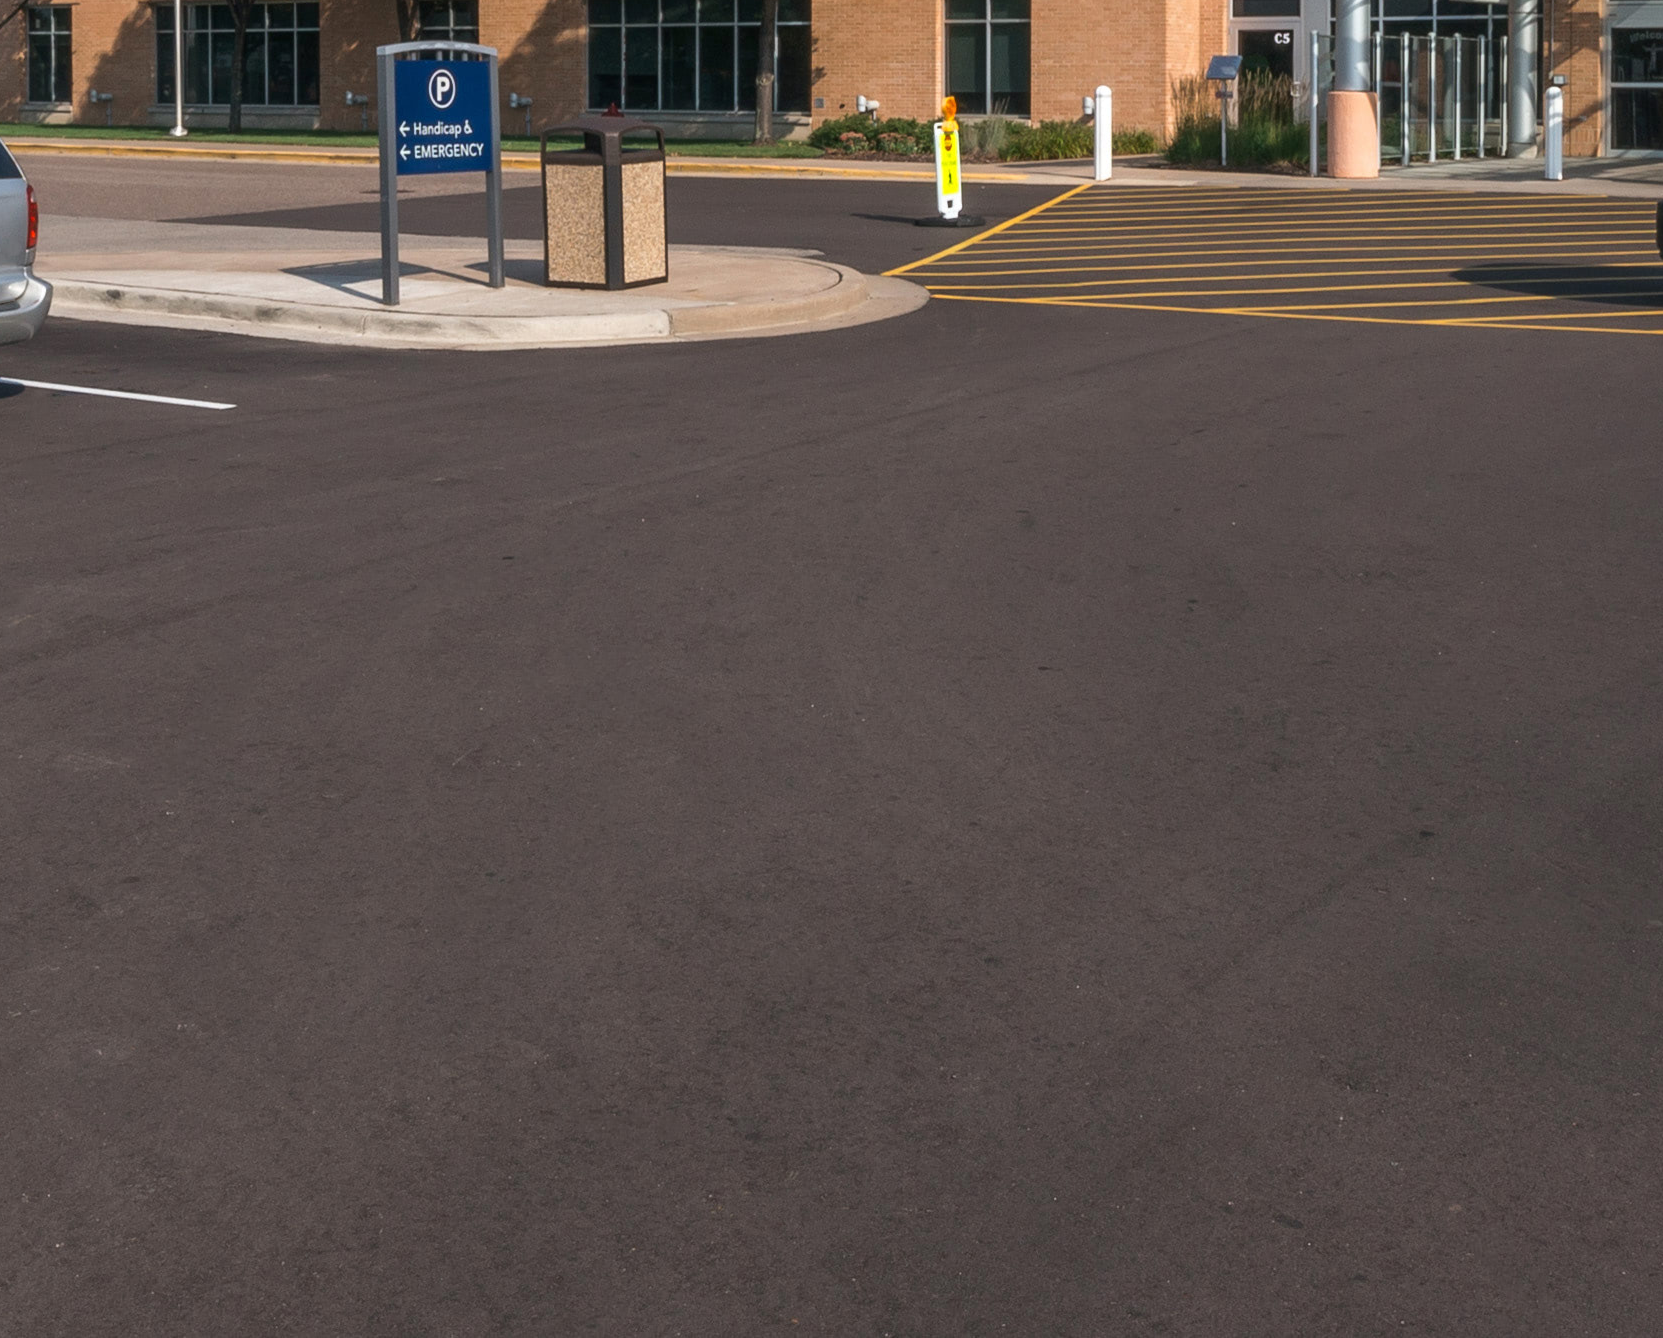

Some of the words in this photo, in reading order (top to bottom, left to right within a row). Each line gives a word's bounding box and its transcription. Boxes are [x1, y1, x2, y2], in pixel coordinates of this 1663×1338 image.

[1274, 33, 1290, 44] C5
[436, 76, 451, 102] P
[413, 121, 462, 139] Handicap
[414, 143, 484, 159] EMERGENCY
